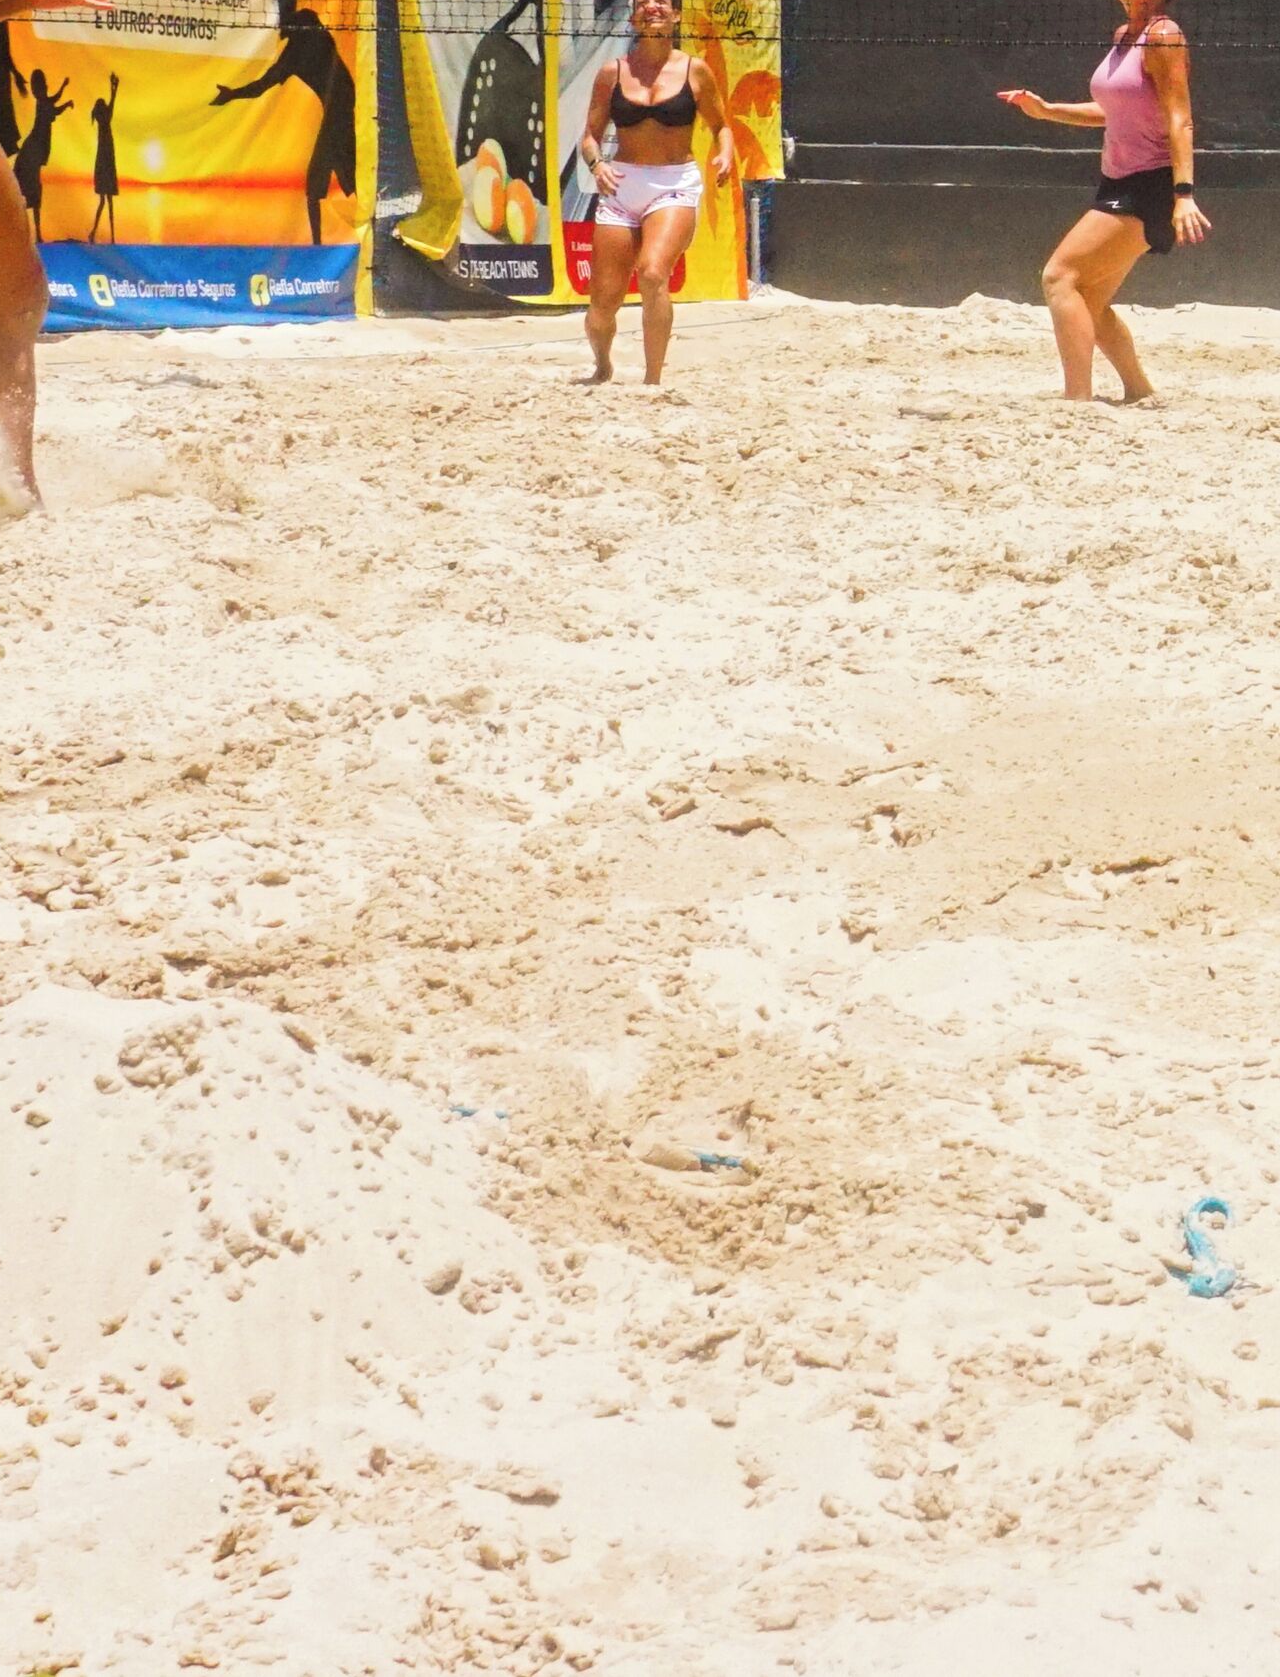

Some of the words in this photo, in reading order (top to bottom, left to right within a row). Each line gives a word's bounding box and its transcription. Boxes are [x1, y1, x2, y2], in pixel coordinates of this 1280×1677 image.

[94, 9, 103, 29] E
[106, 10, 154, 35] OUTROS
[157, 13, 218, 41] SEGUROS!
[479, 260, 508, 280] BEACH
[507, 260, 539, 279] TENNIS
[47, 277, 78, 298] etora
[110, 279, 138, 298] Refla
[138, 279, 185, 299] Corretora
[185, 279, 197, 298] de
[199, 280, 237, 302] Seguros
[269, 277, 293, 297] Refla
[293, 277, 341, 297] Corretora
